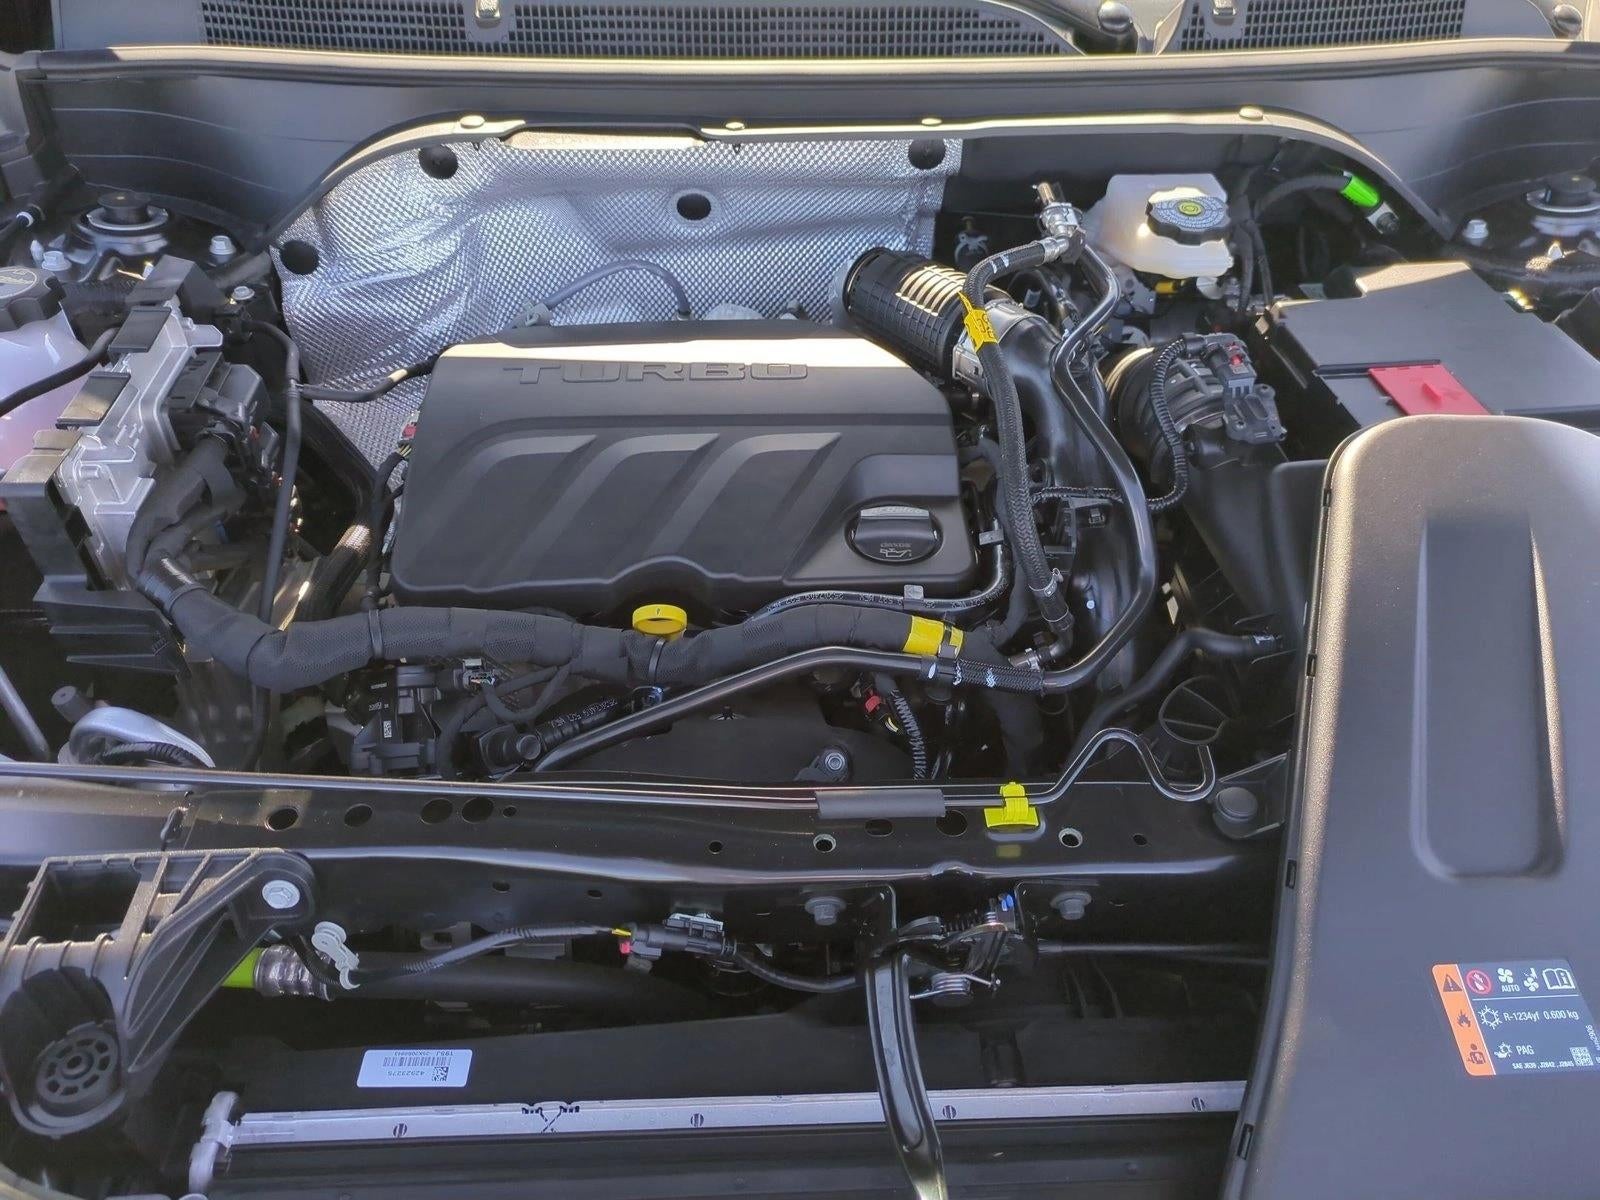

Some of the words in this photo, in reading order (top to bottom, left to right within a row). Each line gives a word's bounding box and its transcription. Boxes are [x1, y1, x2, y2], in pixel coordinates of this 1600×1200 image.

[503, 363, 808, 384] TURBO
[1501, 984, 1520, 992] AUTO
[1503, 1011, 1540, 1022] R-1234yf
[1543, 1010, 1566, 1020] 0.600
[1566, 1009, 1579, 1020] kg
[1516, 1045, 1535, 1055] PAG
